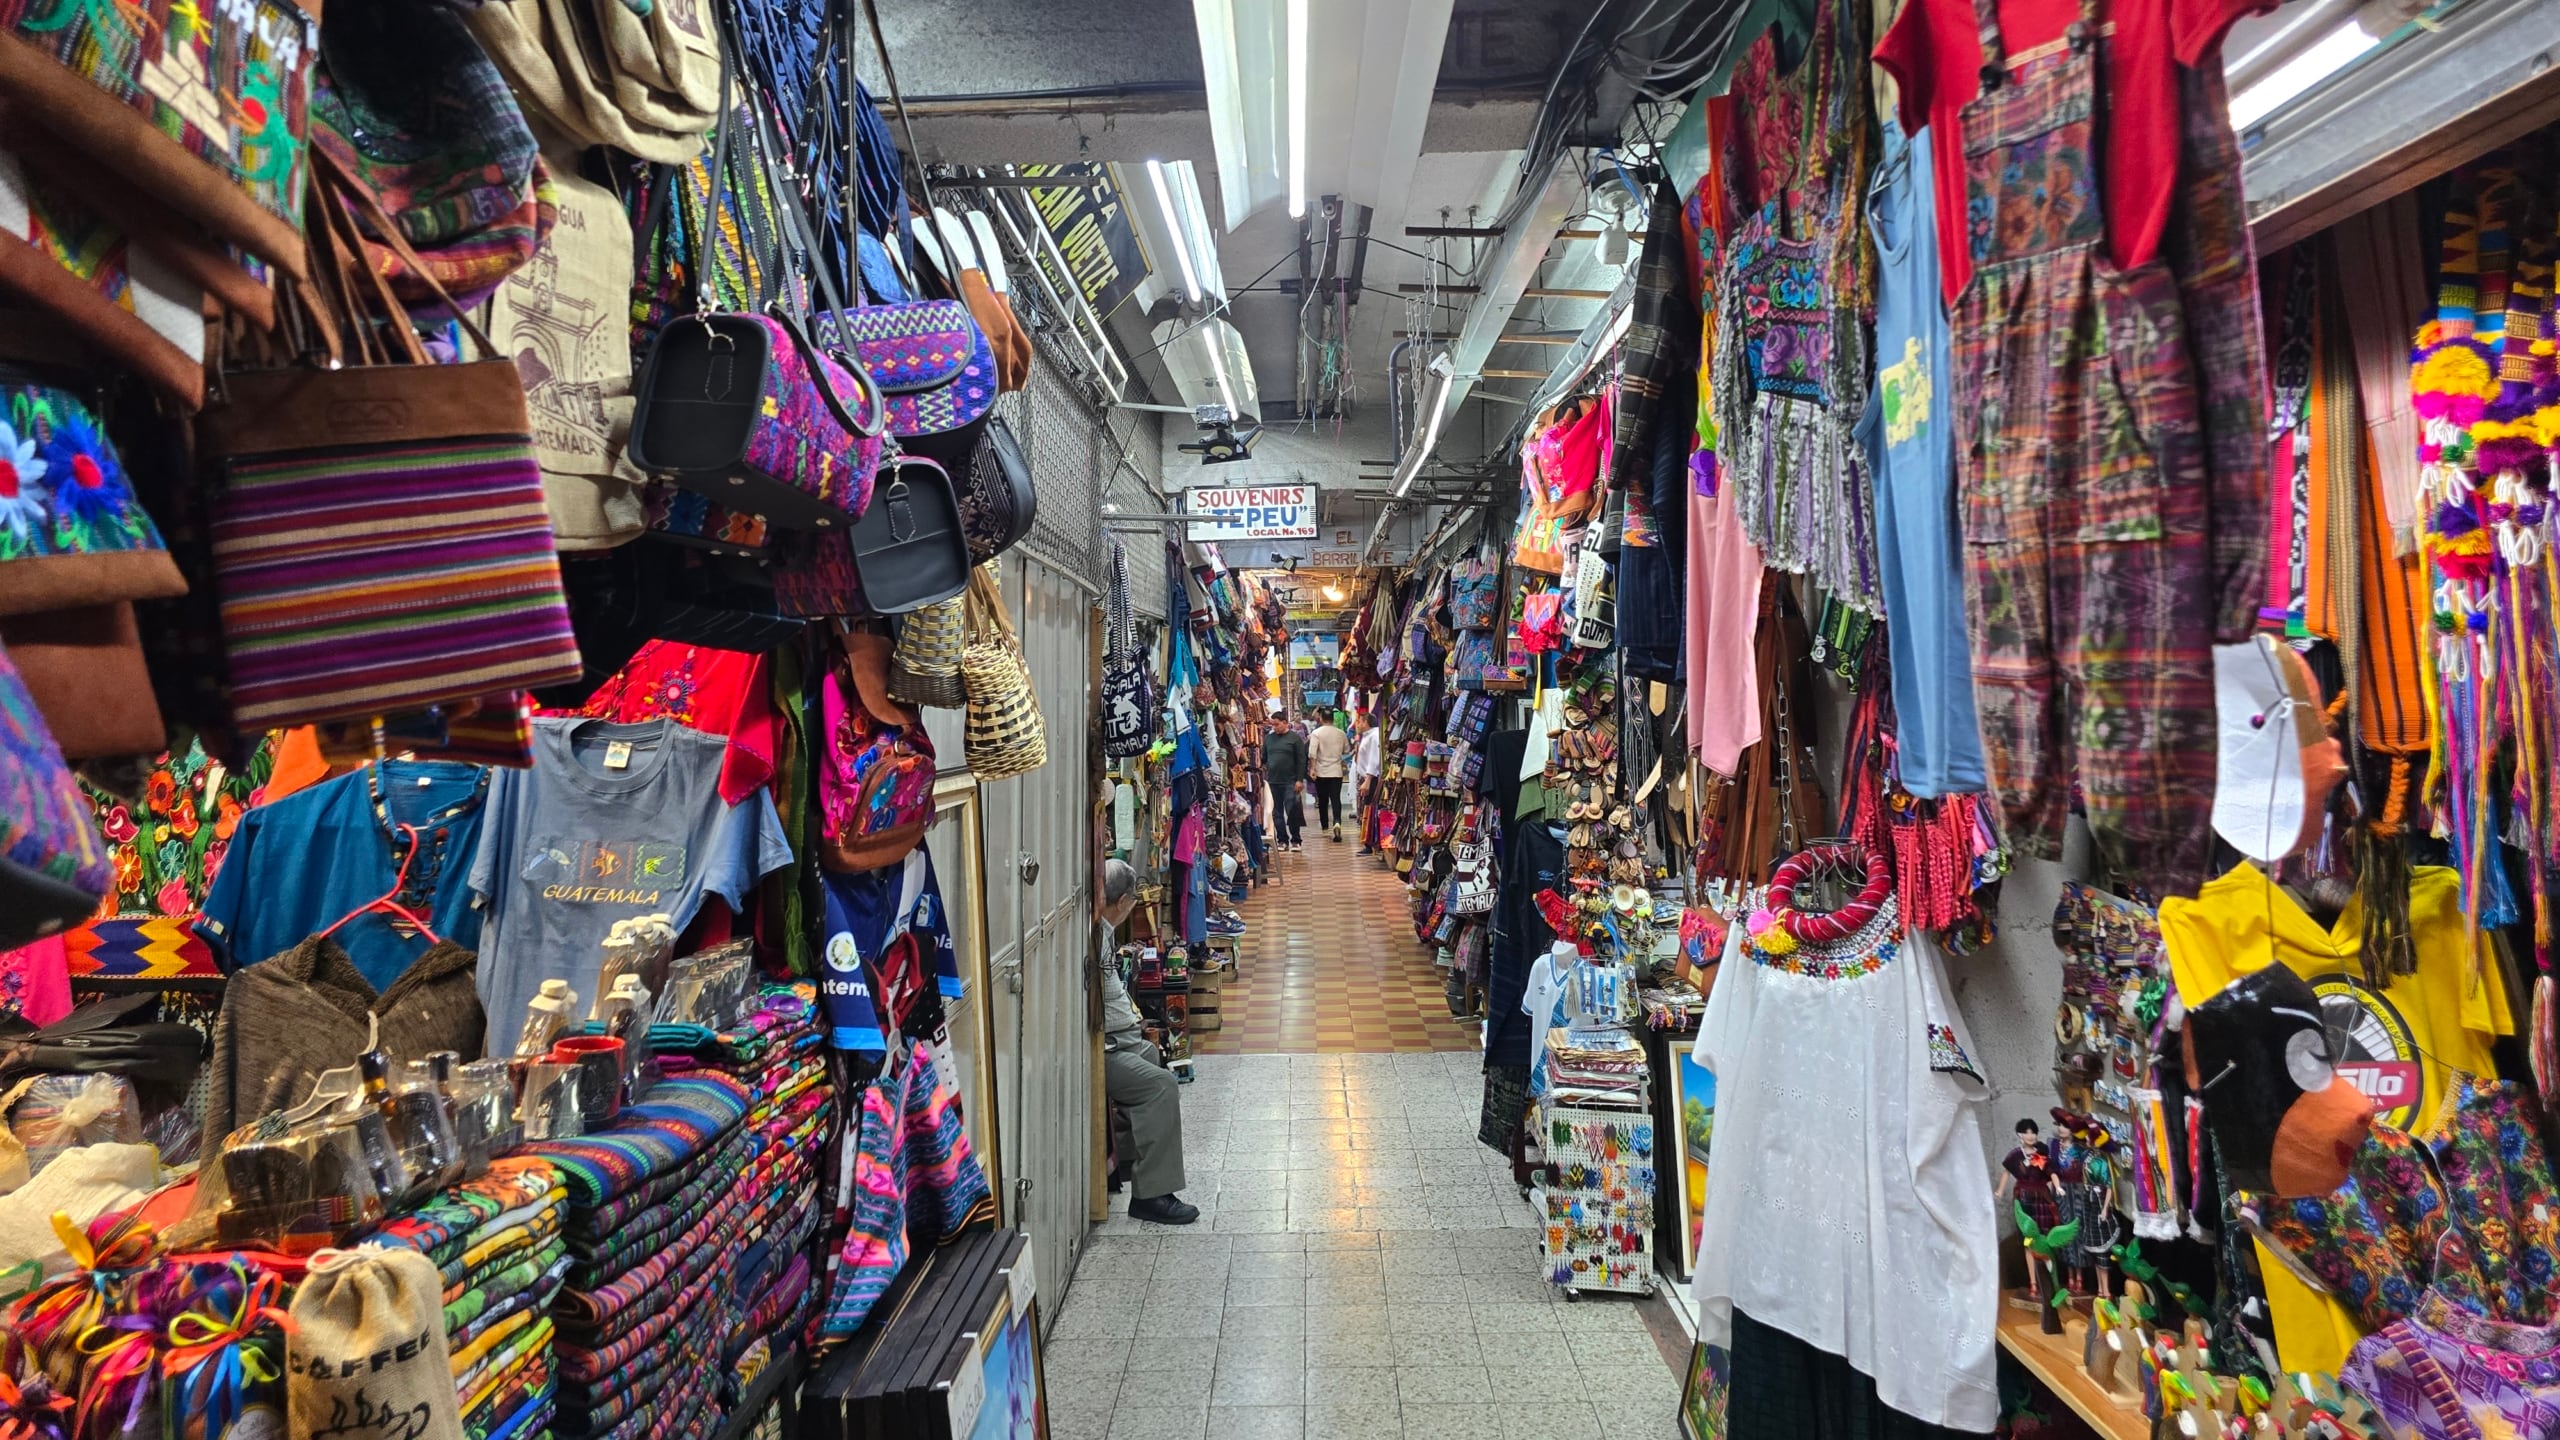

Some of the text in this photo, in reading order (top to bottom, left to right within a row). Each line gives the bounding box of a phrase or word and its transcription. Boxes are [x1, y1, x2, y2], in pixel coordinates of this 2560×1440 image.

[1197, 487, 1306, 508] SOUVENIRS
[1247, 528, 1281, 537] LOCAL
[1336, 530, 1359, 545] EL
[543, 884, 660, 905] GUATEMALA
